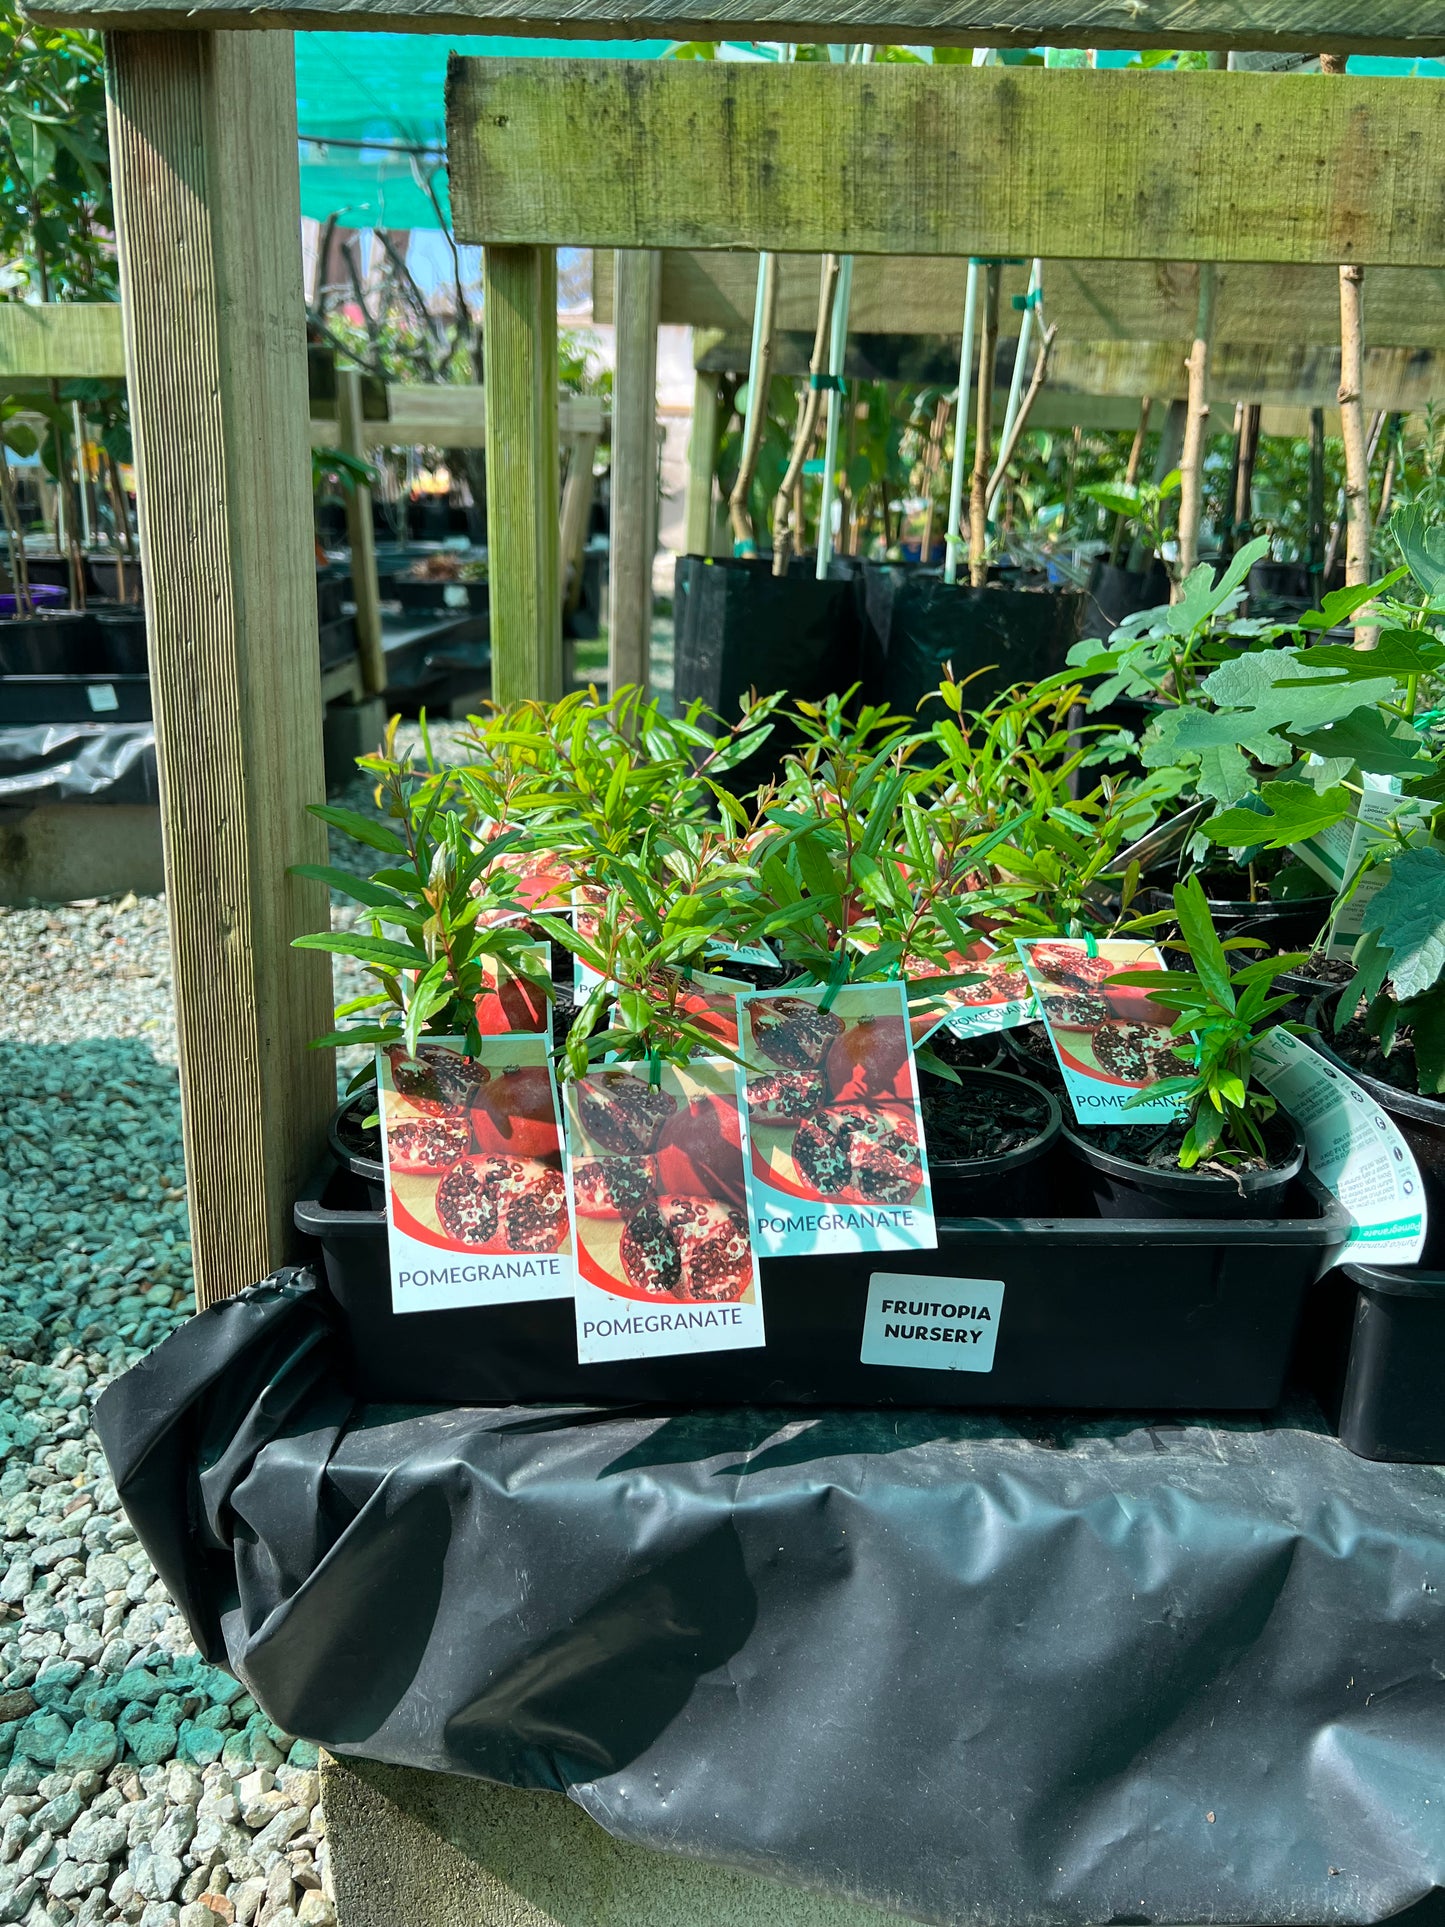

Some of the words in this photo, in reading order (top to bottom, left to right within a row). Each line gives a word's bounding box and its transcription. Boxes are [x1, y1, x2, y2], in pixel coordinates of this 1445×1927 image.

[758, 1210, 915, 1234] POMEGRANATE
[1362, 1221, 1421, 1238] Pomegranate
[398, 1258, 561, 1288] POMEGRANATE
[881, 1299, 991, 1321] FRUITOPIA
[583, 1307, 743, 1339] POMEGRANATE
[884, 1323, 983, 1344] NURSERY
